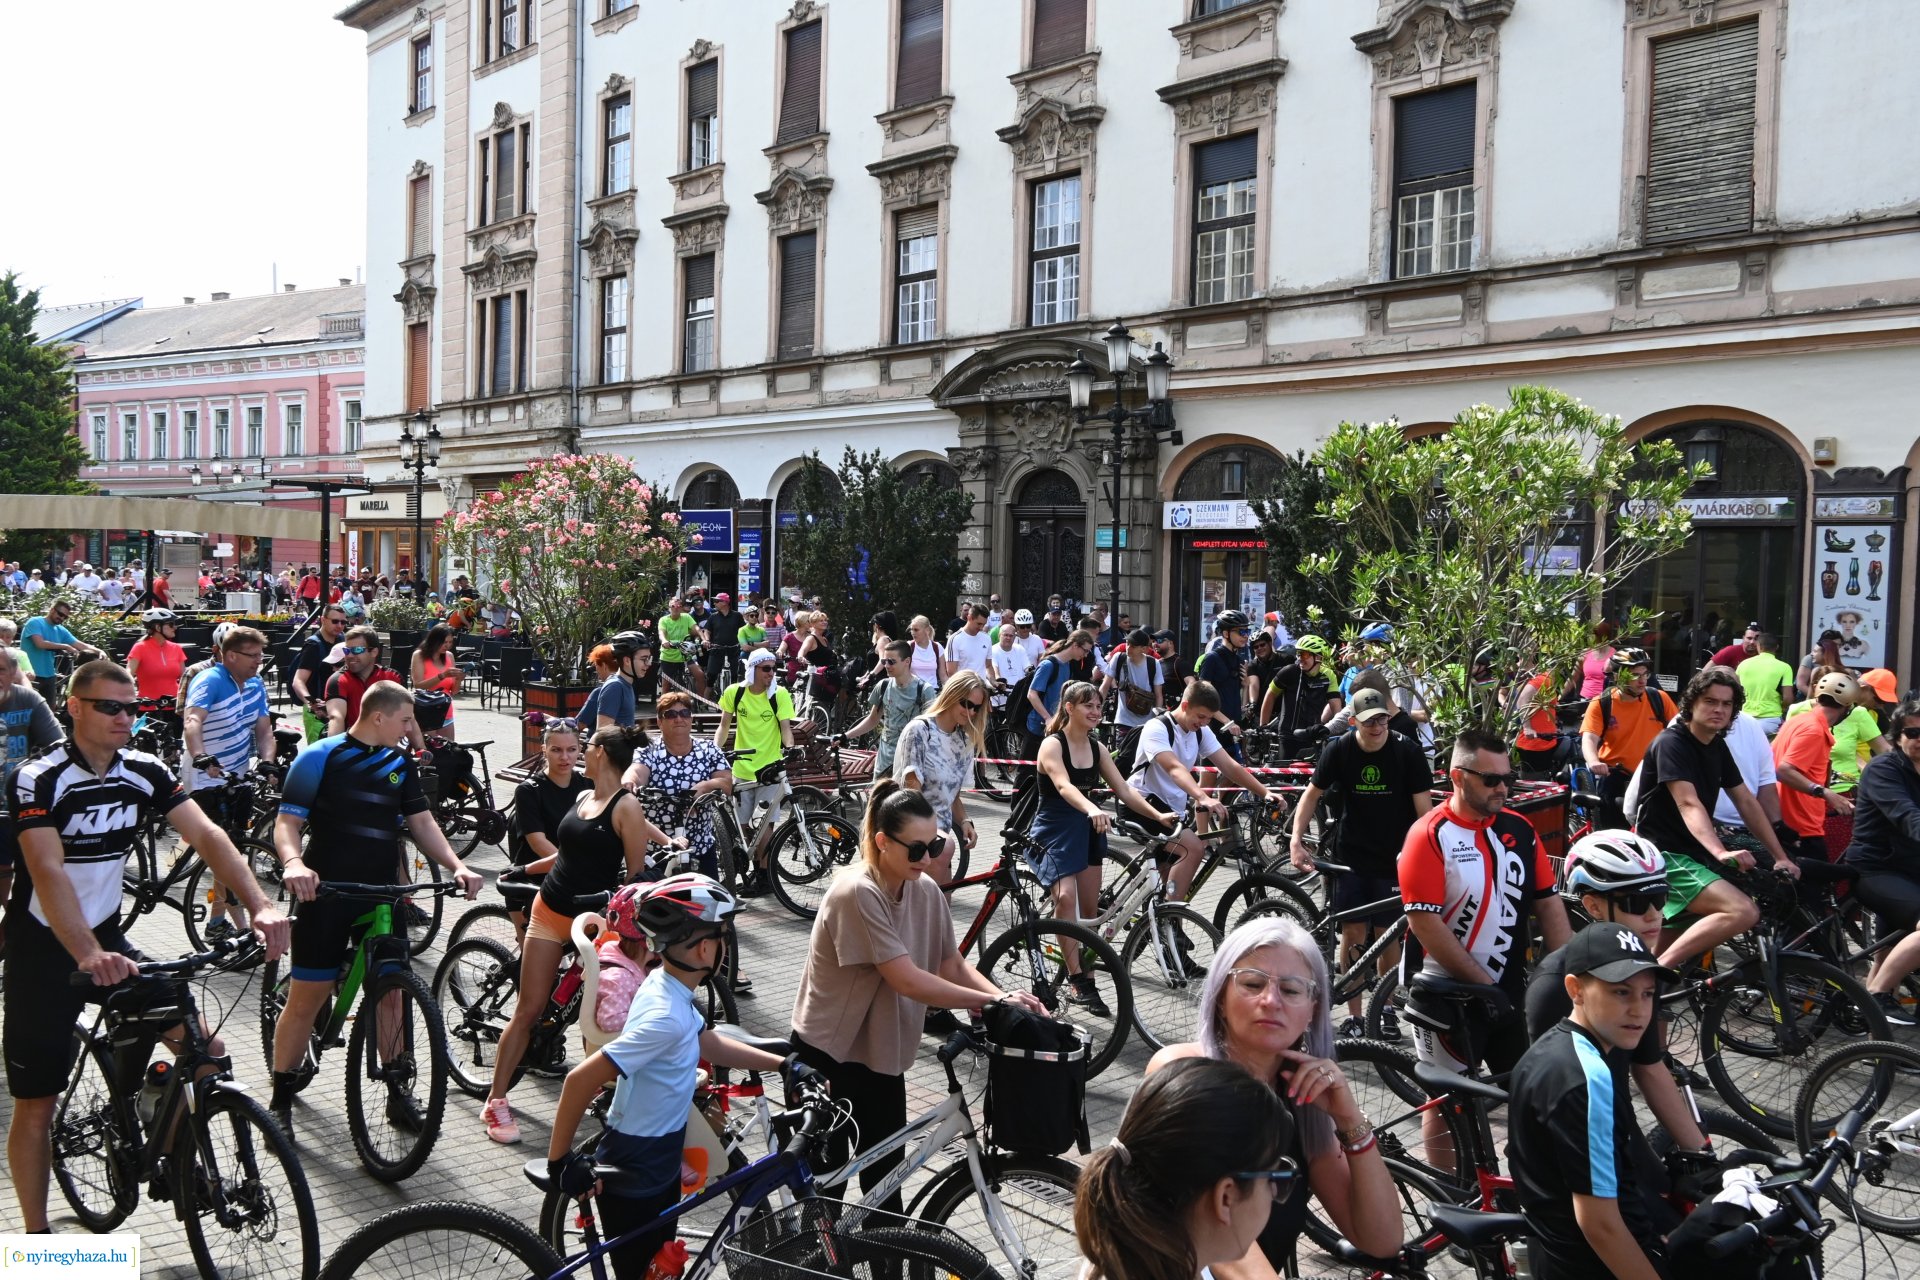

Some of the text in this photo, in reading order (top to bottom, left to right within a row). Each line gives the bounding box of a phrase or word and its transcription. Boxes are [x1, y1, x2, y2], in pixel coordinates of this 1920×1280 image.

[360, 500, 389, 511] MARELLA
[1240, 540, 1256, 548] VAGY
[61, 800, 139, 836] KTM
[1403, 903, 1443, 914] GIANT
[1452, 894, 1480, 943] ANT
[1487, 850, 1526, 985] GIANT
[1348, 921, 1398, 975] ROCKRIDER
